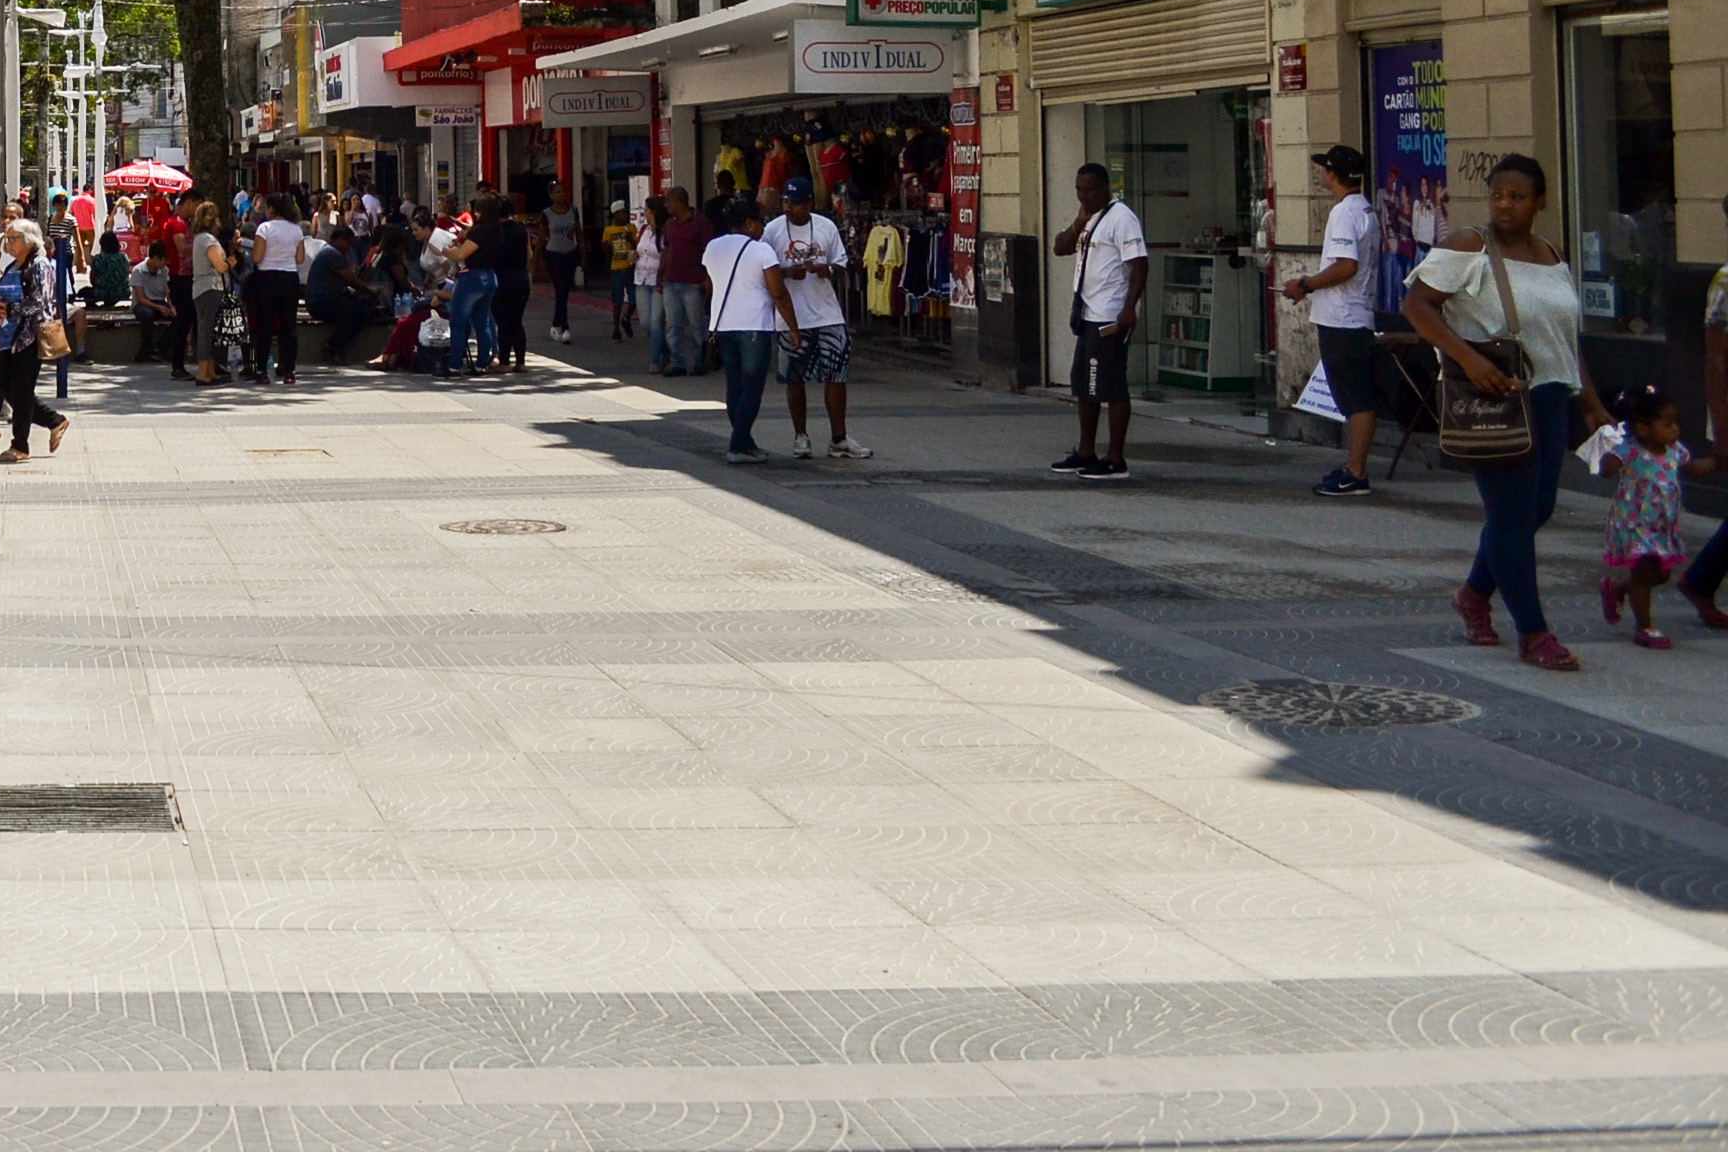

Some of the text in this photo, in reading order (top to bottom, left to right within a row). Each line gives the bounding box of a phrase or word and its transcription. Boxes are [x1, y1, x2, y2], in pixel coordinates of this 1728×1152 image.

[822, 44, 927, 69] INDIVIDUAL
[562, 93, 633, 111] INDIVIDUAL
[1384, 90, 1414, 109] CARTÃO
[433, 114, 474, 124] São João
[434, 106, 473, 115] FARMÁCIAS
[1399, 112, 1420, 129] GANG
[959, 207, 973, 224] em
[223, 316, 243, 327] VIP
[1088, 366, 1098, 396] ELEMENT
